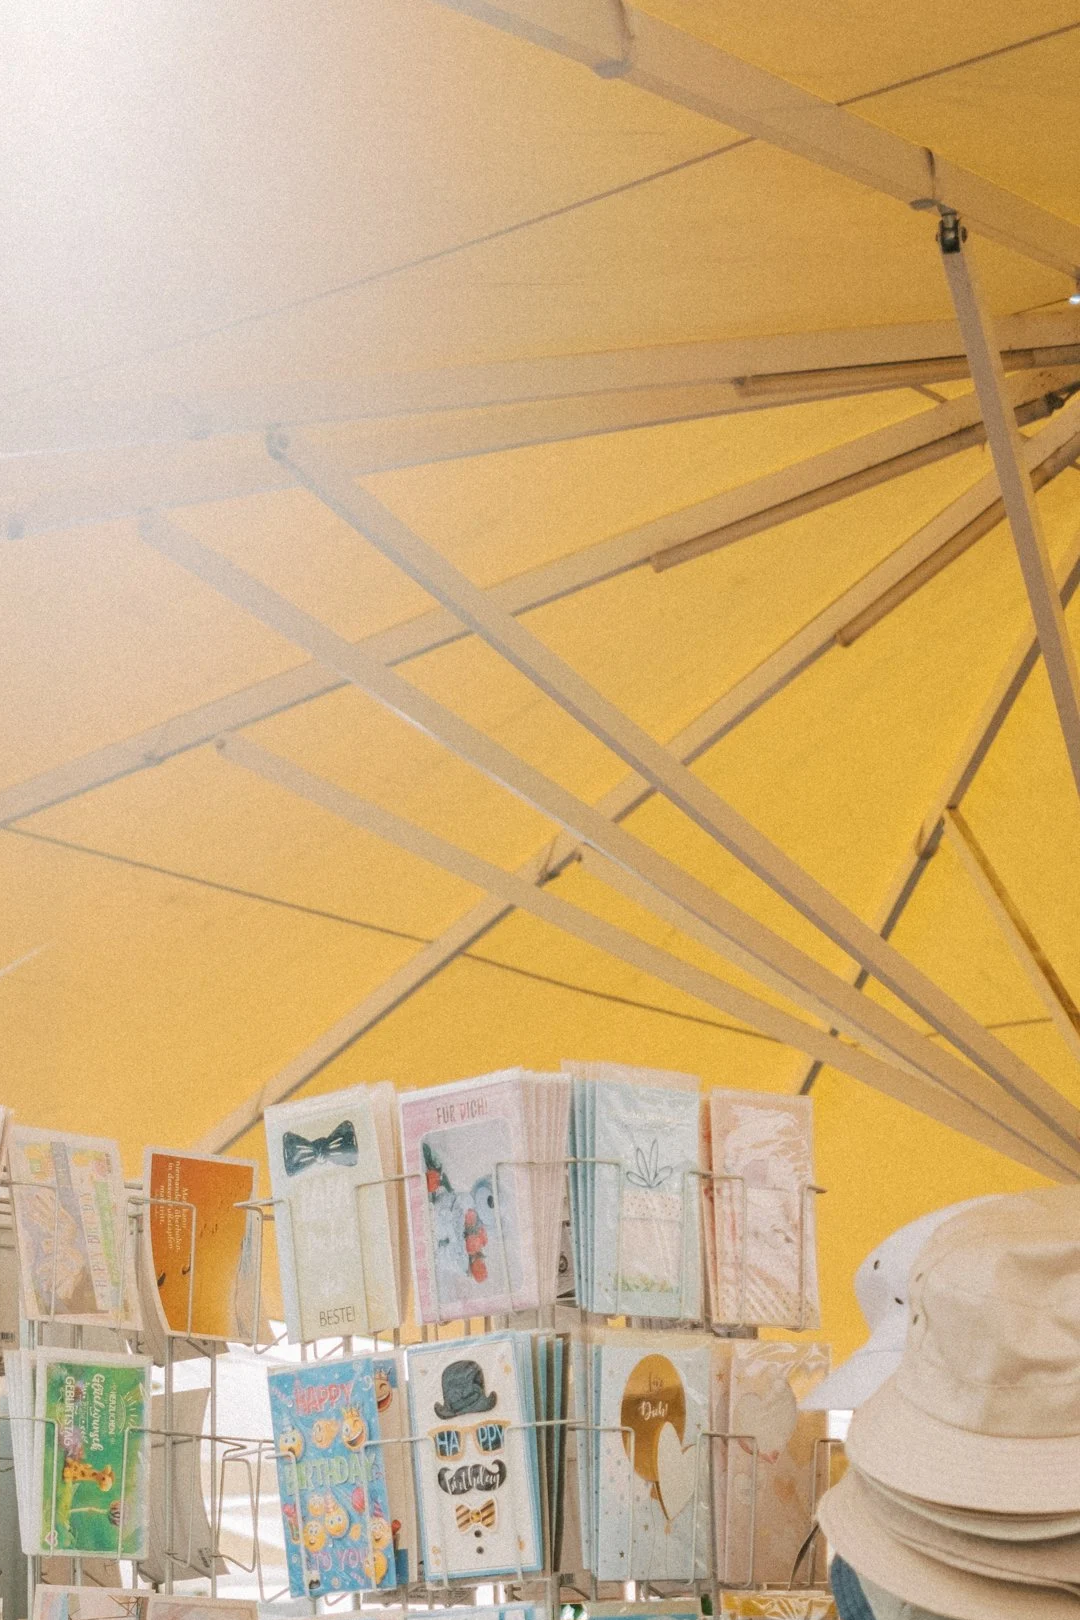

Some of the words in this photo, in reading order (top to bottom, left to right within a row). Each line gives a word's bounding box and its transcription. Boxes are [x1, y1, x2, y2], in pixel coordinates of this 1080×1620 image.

[437, 1106, 456, 1124] FÜR
[460, 1097, 488, 1120] DICH!
[320, 1306, 356, 1327] BESTE!
[63, 1376, 75, 1447] GEBURTSTAG
[294, 1381, 354, 1415] HAPPY
